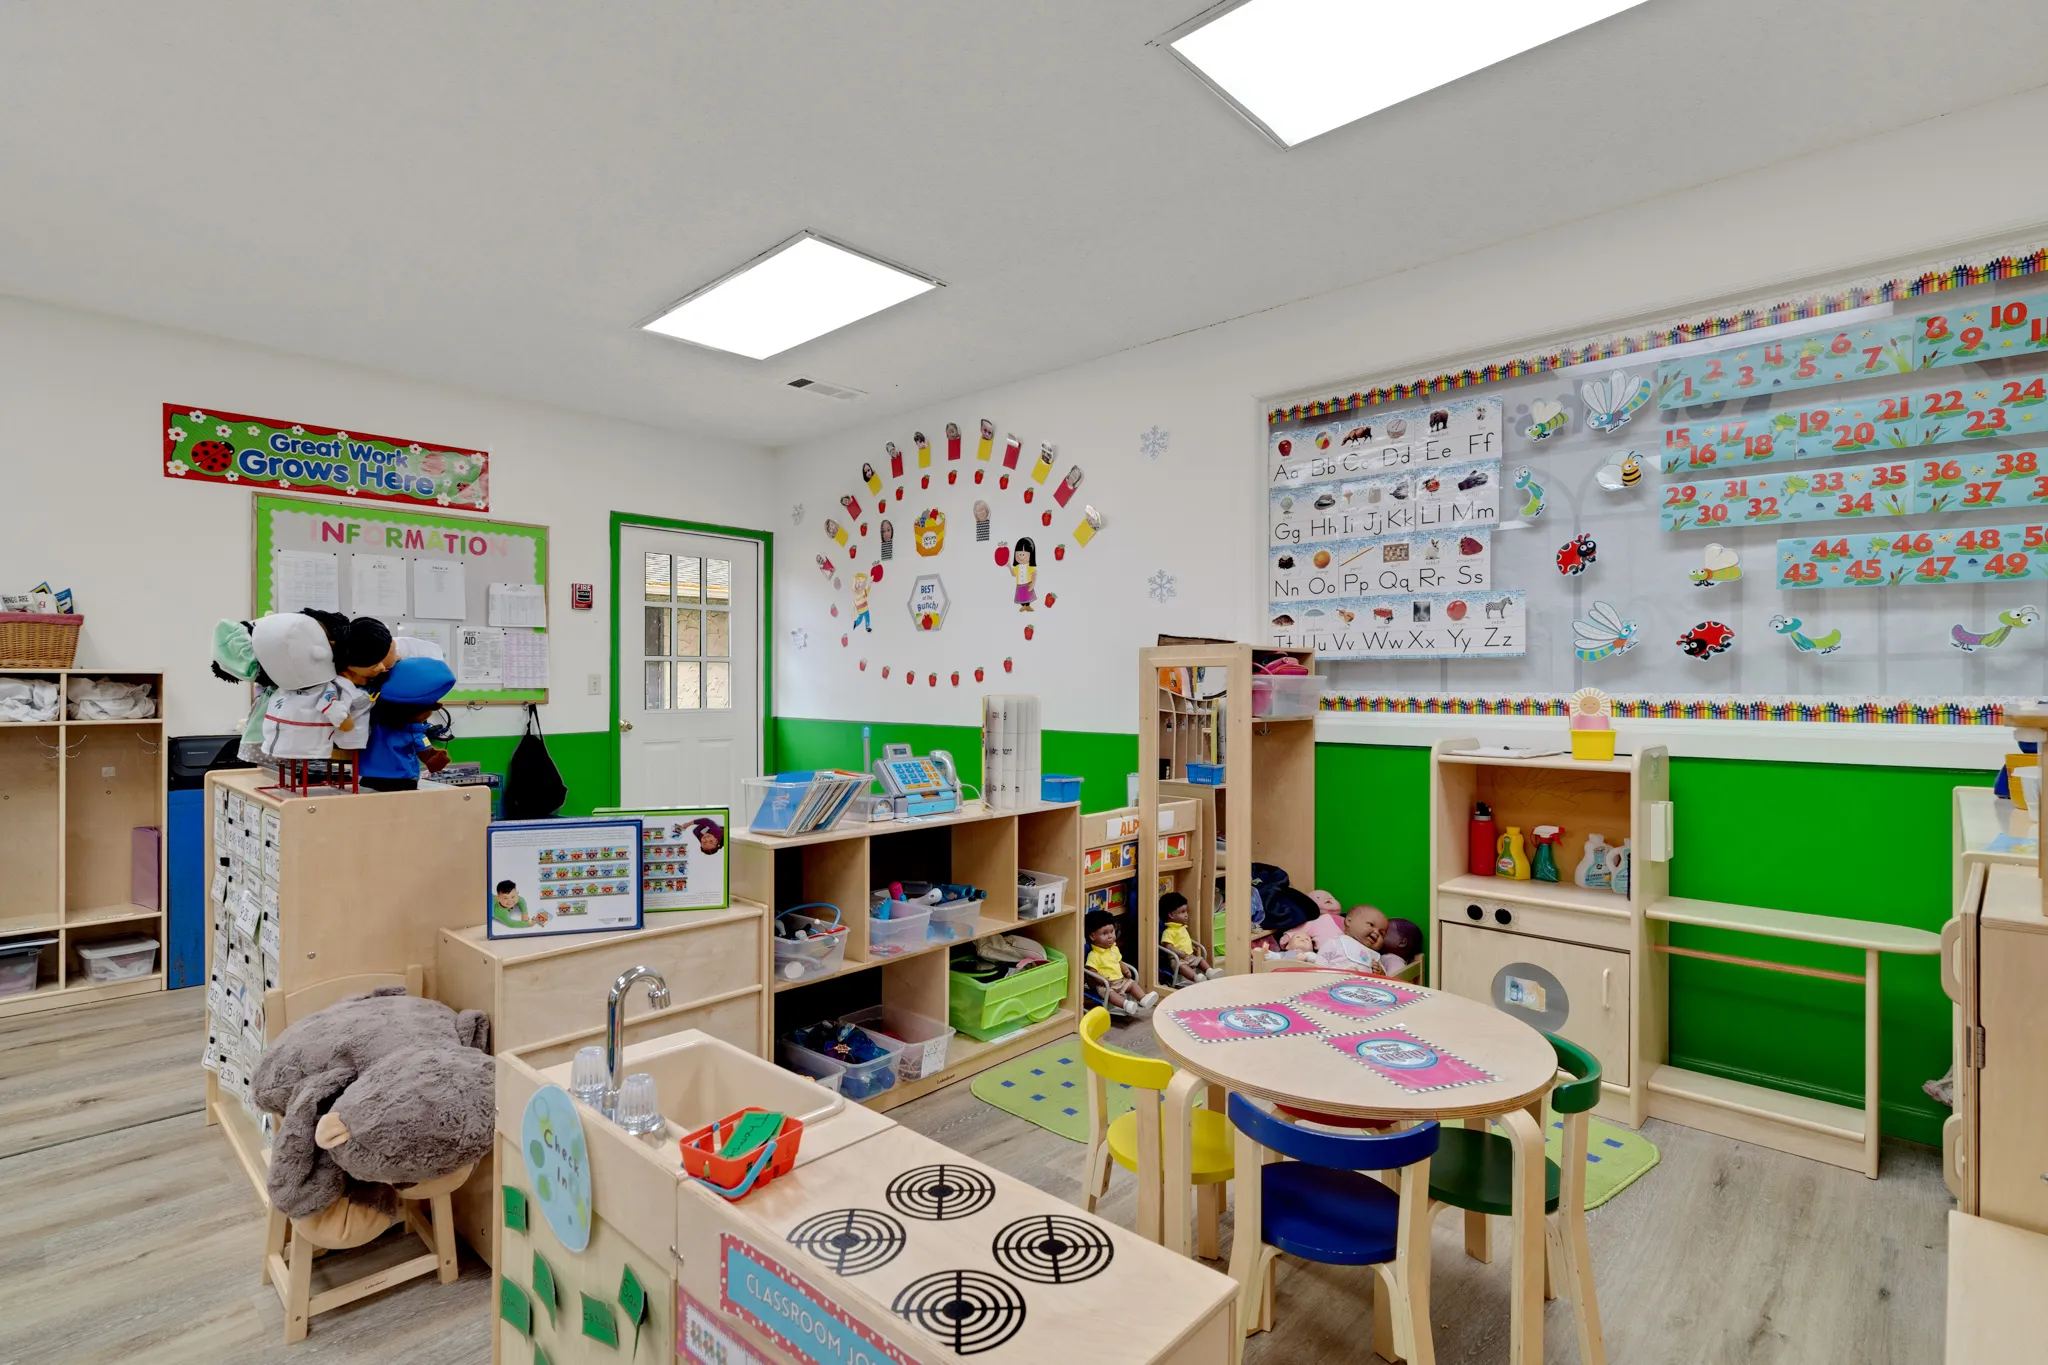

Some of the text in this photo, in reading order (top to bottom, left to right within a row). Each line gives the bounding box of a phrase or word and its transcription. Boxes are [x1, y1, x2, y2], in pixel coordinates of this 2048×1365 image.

[1684, 302, 2048, 397] 1 2 3 4 5 6 7 8 9 10 1
[1666, 378, 2047, 465] 15 16 17 18 19 20 21 22 23 24
[238, 448, 435, 496] Grows Here
[269, 433, 408, 469] Great Work
[1666, 486, 1697, 504] 29
[1697, 504, 1728, 523] 30
[1724, 480, 1747, 498] 31
[1747, 497, 1779, 517] 32
[1811, 472, 1844, 492] 33
[1837, 492, 1874, 513] 34
[1871, 465, 1906, 486] 35
[1923, 460, 1962, 482] 36
[1963, 481, 2003, 504] 37
[1995, 452, 2038, 475] 38
[310, 519, 508, 557] INFORMATION
[1784, 526, 2048, 582] 43 44 45 46 47 48 49 5
[920, 584, 935, 594] BEST
[464, 637, 477, 645] AID
[544, 1129, 580, 1178] Check
[556, 1166, 568, 1190] In
[746, 1273, 841, 1357] CLASSROOM
